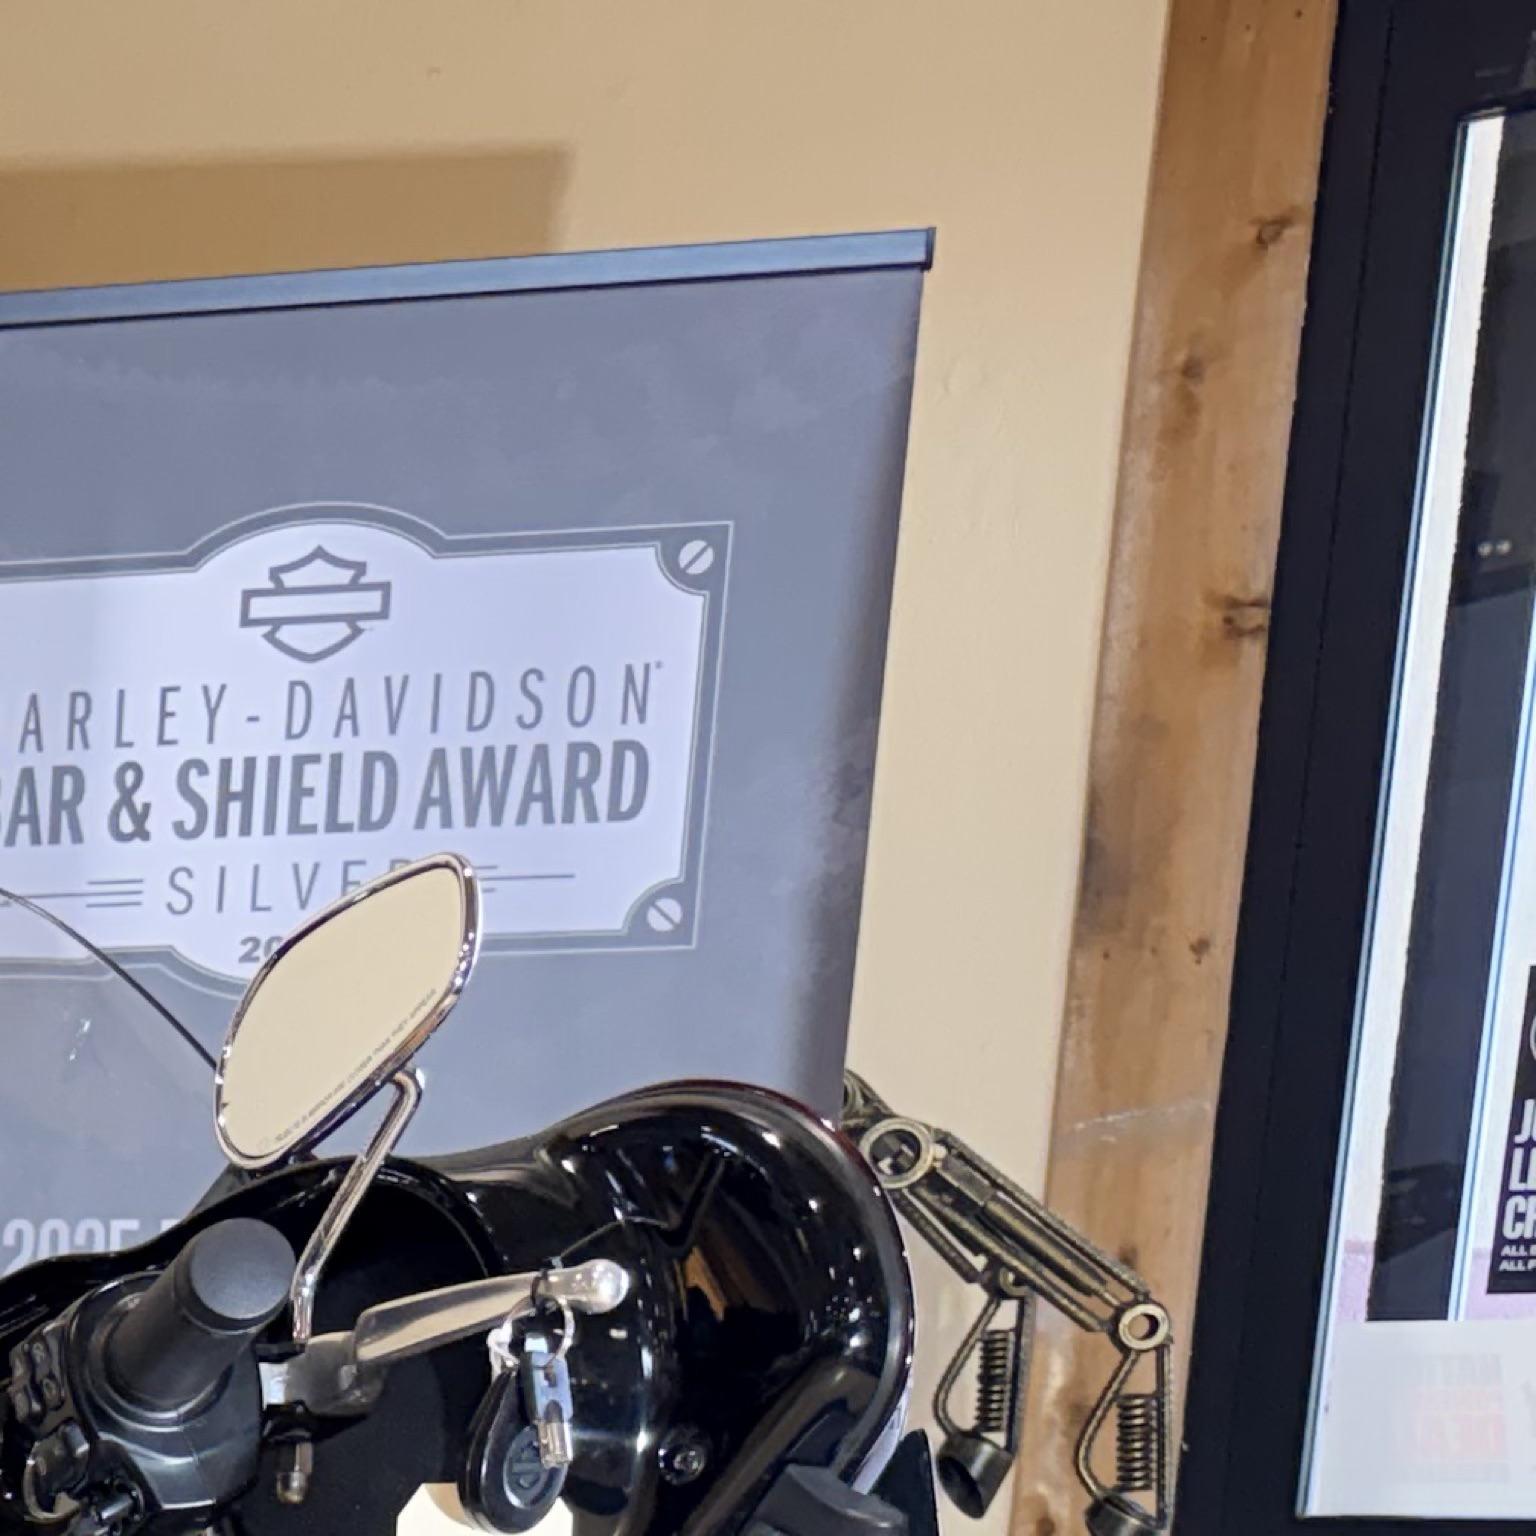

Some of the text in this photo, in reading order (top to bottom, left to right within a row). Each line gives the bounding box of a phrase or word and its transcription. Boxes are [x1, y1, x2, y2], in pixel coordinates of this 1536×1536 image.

[107, 760, 153, 842] &
[171, 749, 398, 841] SHIELD
[413, 738, 651, 831] AWARD
[165, 858, 413, 916] SILVE
